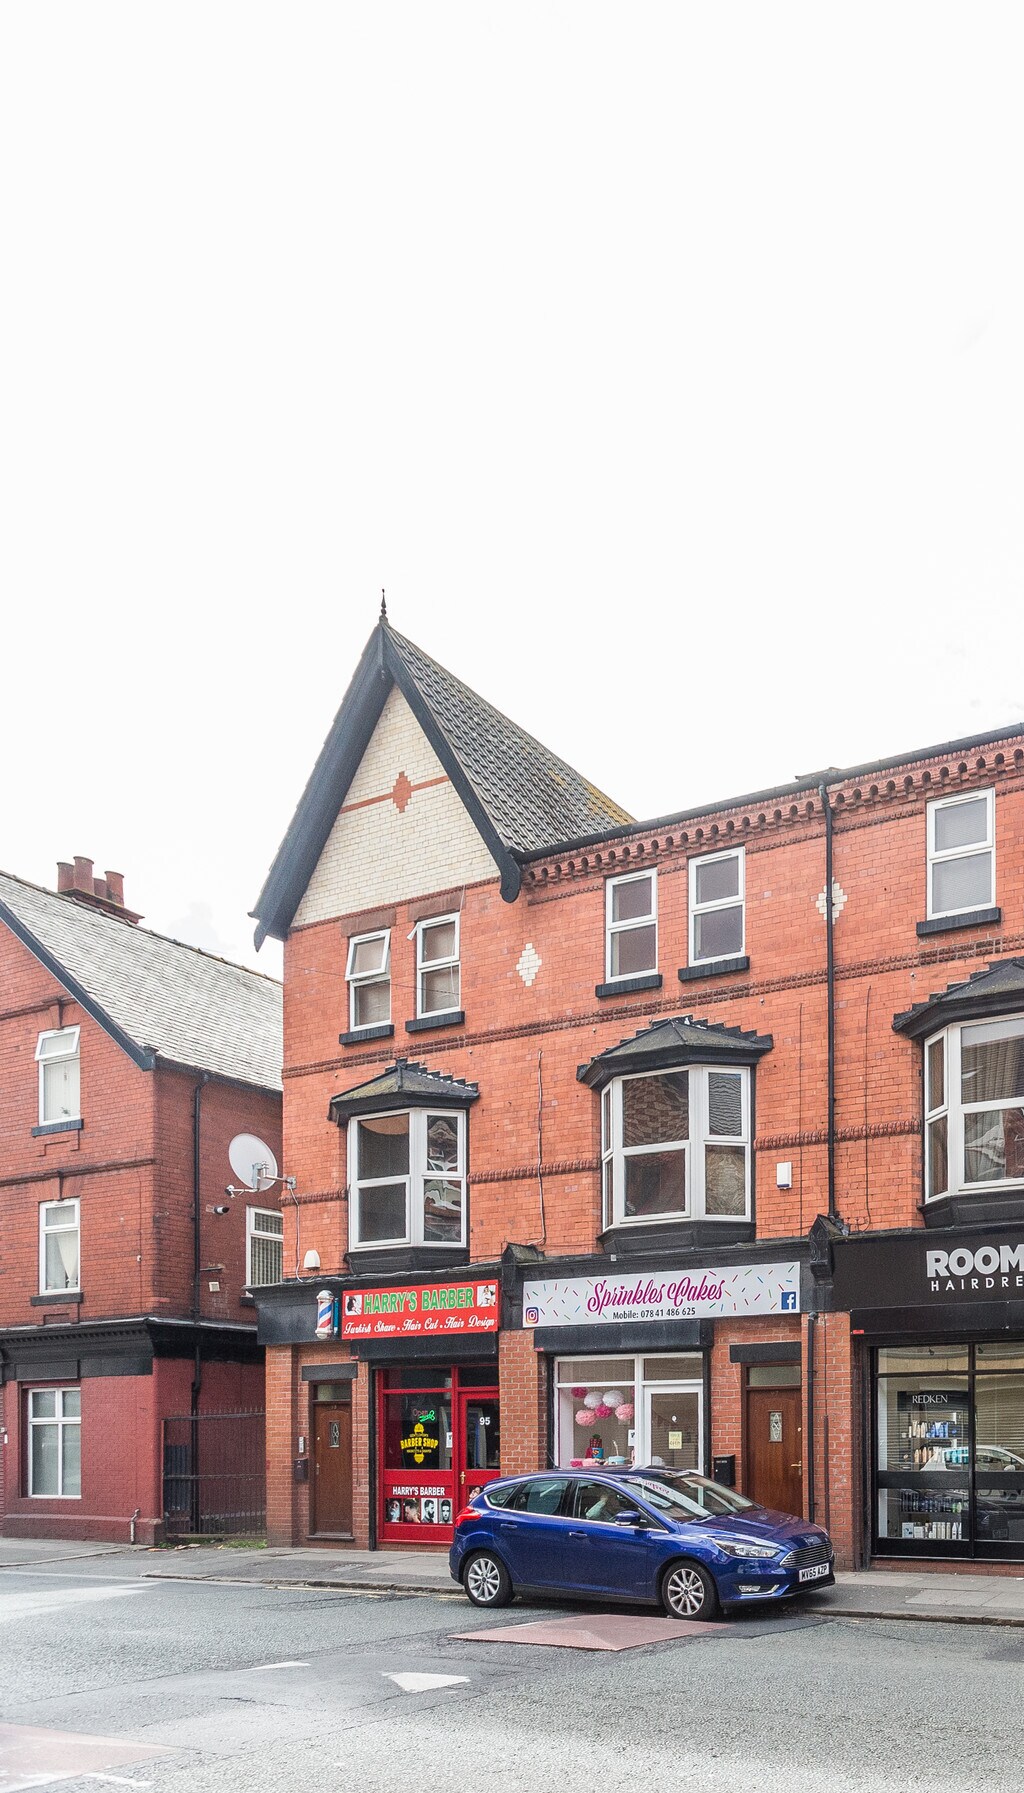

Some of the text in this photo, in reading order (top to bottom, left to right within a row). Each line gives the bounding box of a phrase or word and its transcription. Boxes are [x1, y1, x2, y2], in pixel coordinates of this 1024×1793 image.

[363, 1287, 475, 1315] HARRY'S BARBER
[587, 1275, 726, 1315] Sprinkles Cakes
[612, 1310, 639, 1320] Mobile:
[666, 1308, 680, 1317] 486
[682, 1307, 696, 1316] 625
[343, 1315, 495, 1334] Turkish Shave Hair Cut Hair Design
[912, 1394, 948, 1404] REDKEN
[479, 1416, 491, 1426] 95
[400, 1437, 439, 1450] BARBER SHOP
[392, 1486, 445, 1496] HARRY'S BARBER
